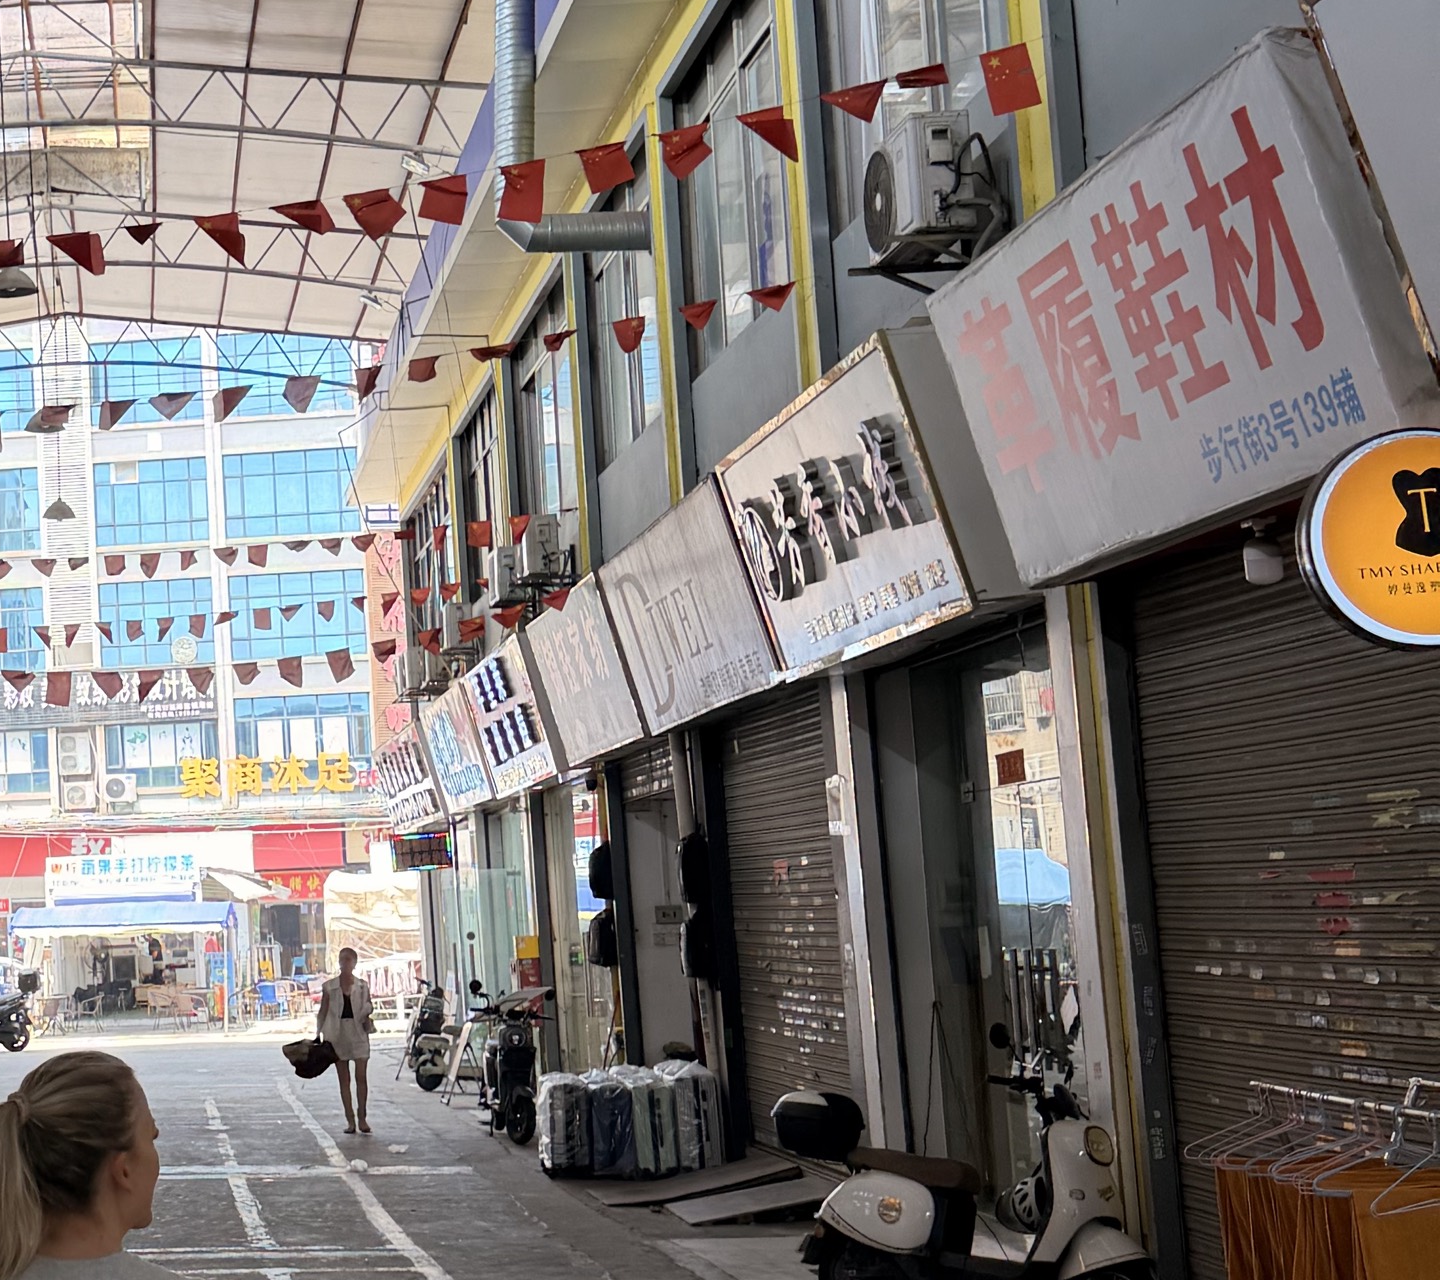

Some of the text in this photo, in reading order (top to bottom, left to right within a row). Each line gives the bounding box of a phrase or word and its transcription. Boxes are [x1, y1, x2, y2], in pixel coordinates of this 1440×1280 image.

[1201, 367, 1367, 484] 步行街3号139铺
[1358, 566, 1396, 580] TMY
[179, 751, 355, 799] 聚商沐足
